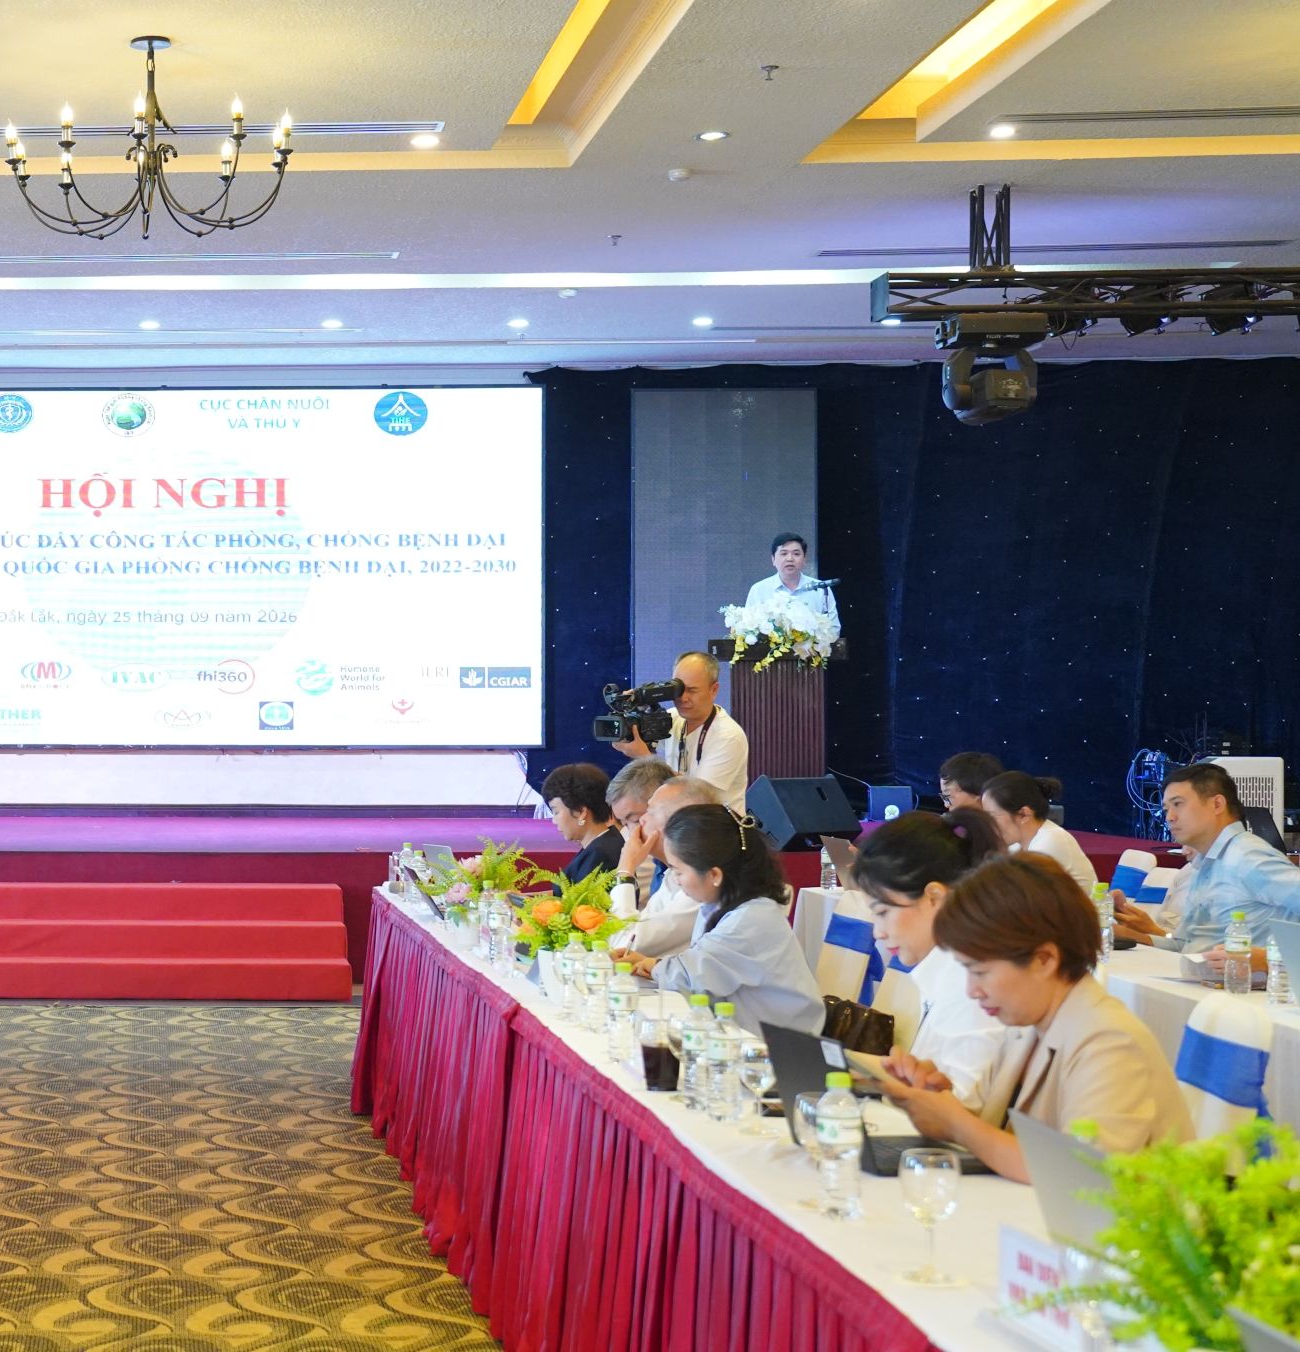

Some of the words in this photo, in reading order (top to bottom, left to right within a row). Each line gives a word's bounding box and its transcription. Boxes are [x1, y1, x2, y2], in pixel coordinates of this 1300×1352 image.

[199, 399, 232, 412] CỤC
[287, 395, 330, 410] NUÔI
[292, 418, 301, 429] Y
[37, 473, 136, 518] HỘI
[152, 477, 290, 517] NGHỊ
[89, 530, 155, 549] CÔNG
[161, 530, 208, 548] TÁC
[214, 530, 301, 550] PHÒNG,
[466, 533, 507, 550] DẠI
[74, 560, 116, 575] GIA
[121, 556, 201, 575] PHÒNG
[367, 559, 413, 577] DẠI,
[419, 559, 517, 574] 2022-2030
[66, 610, 107, 625] ngày
[112, 611, 131, 623] 25
[190, 611, 209, 623] 09
[196, 670, 248, 684] fhi360
[340, 674, 369, 682] World
[489, 676, 528, 687] CGIAR
[340, 682, 380, 691] Animals
